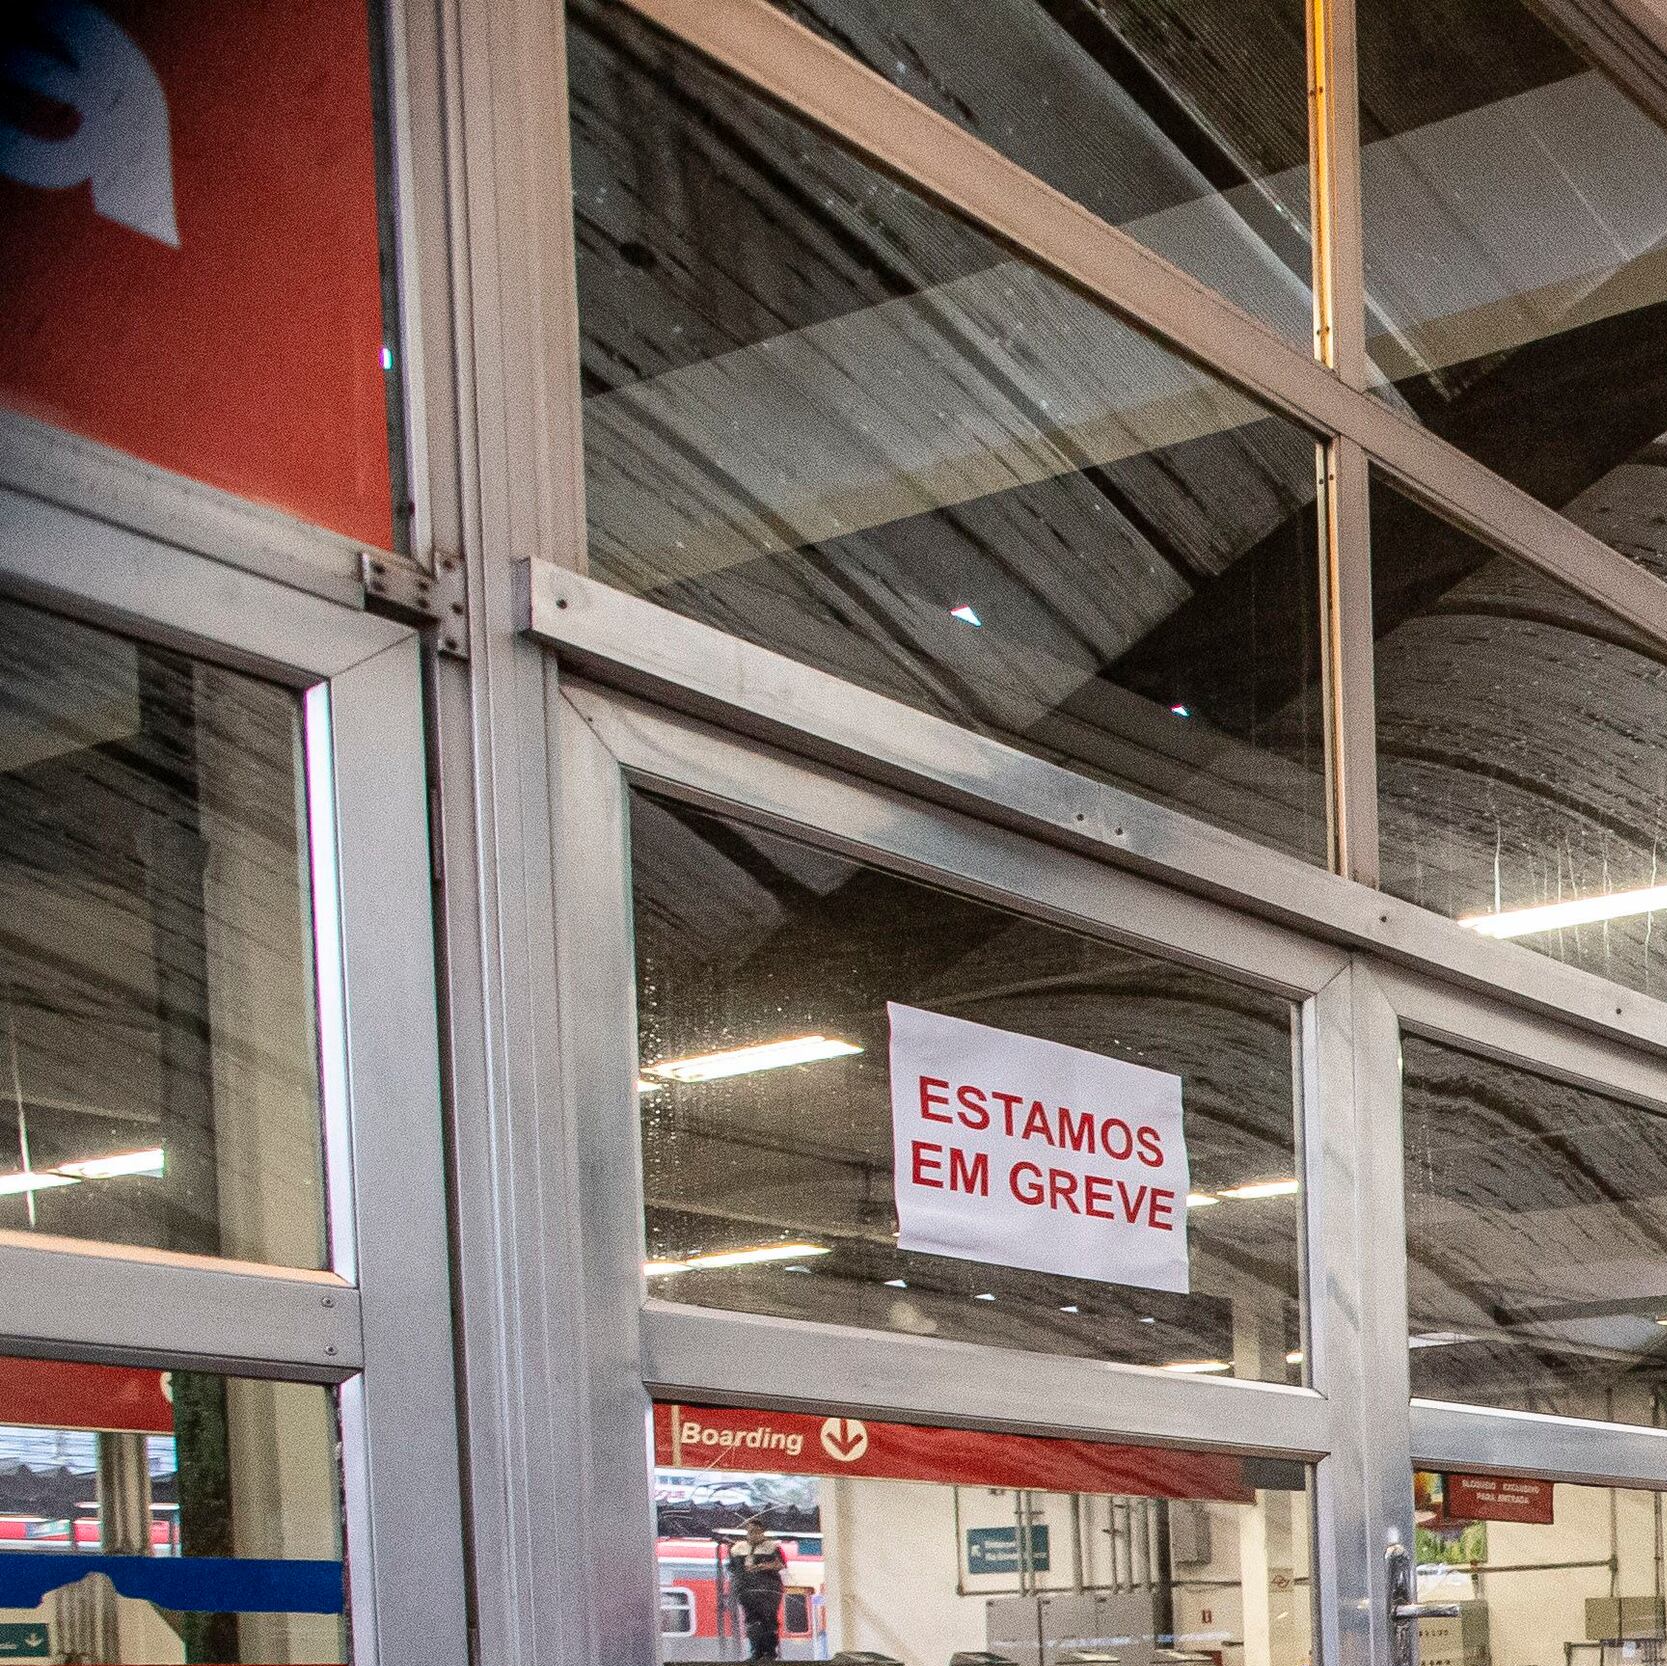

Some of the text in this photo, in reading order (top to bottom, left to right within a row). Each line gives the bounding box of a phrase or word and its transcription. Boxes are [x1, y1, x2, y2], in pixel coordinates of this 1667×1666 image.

[918, 1075, 1165, 1168] ESTAMOS
[910, 1139, 1175, 1231] EM GREVE
[681, 1421, 804, 1456] Boarding
